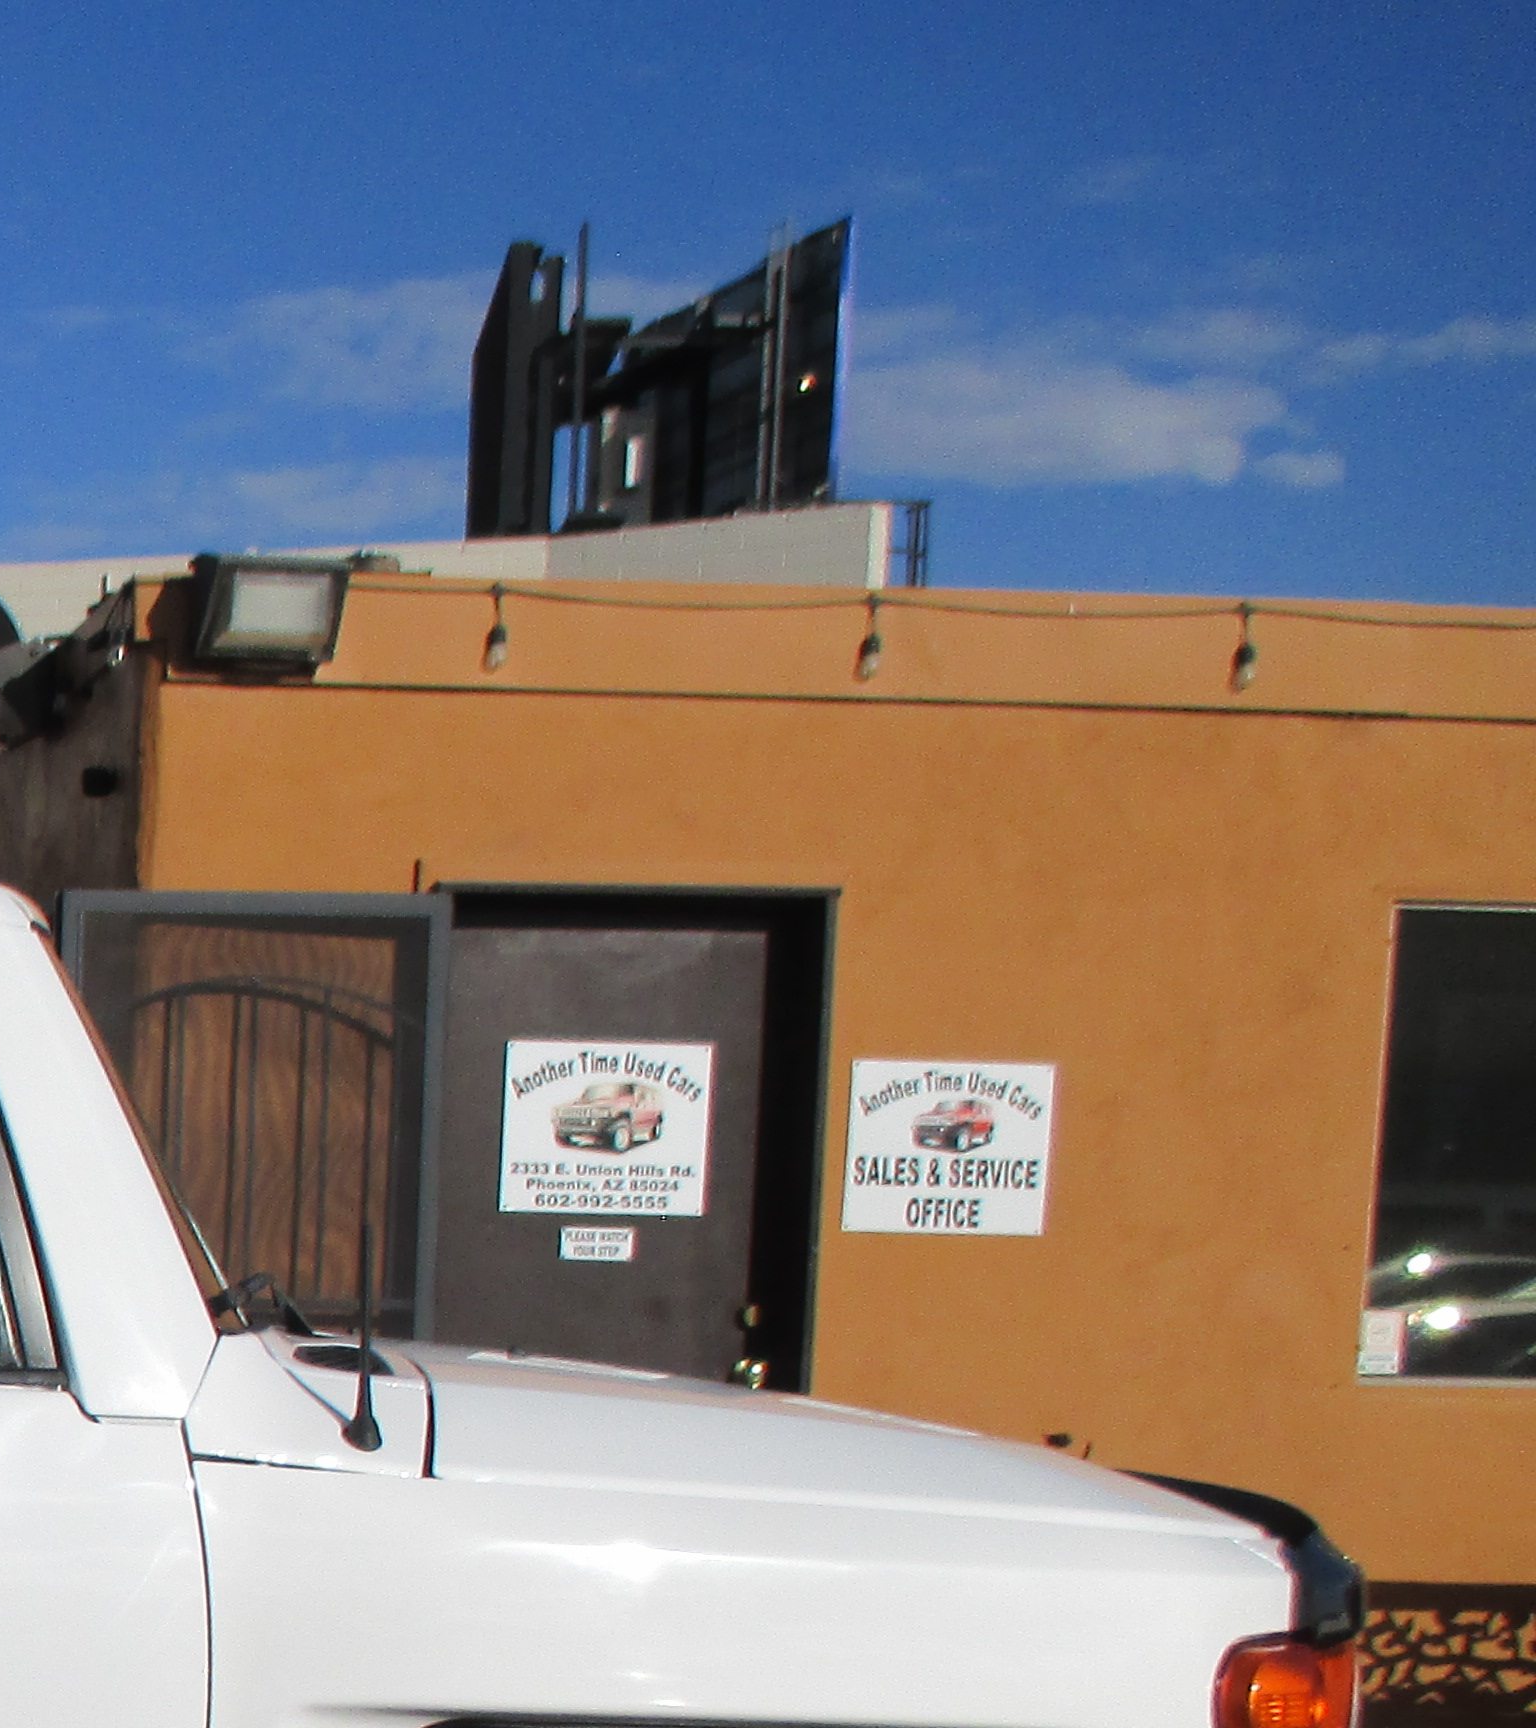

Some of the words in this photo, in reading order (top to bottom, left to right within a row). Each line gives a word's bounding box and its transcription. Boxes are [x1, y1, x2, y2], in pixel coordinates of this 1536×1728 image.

[510, 1058, 574, 1099] Another
[579, 1051, 618, 1074] Time
[624, 1053, 665, 1082] Used
[666, 1067, 702, 1102] Cars
[859, 1078, 919, 1116] Another
[923, 1071, 962, 1093] Time
[968, 1072, 1006, 1099] Used
[1009, 1085, 1042, 1120] Cars
[510, 1162, 549, 1175] 2333
[576, 1164, 623, 1177] Union
[629, 1165, 664, 1177] Hills
[669, 1165, 695, 1178] Rd.
[525, 1179, 596, 1192] Phoenix,
[601, 1179, 624, 1192] AZ
[630, 1179, 679, 1192] 85024
[853, 1156, 920, 1186] SALES
[926, 1157, 941, 1187] &
[948, 1158, 1038, 1189] SERVICE
[534, 1194, 668, 1209] 602-992-5555
[905, 1197, 979, 1228] OFFICE
